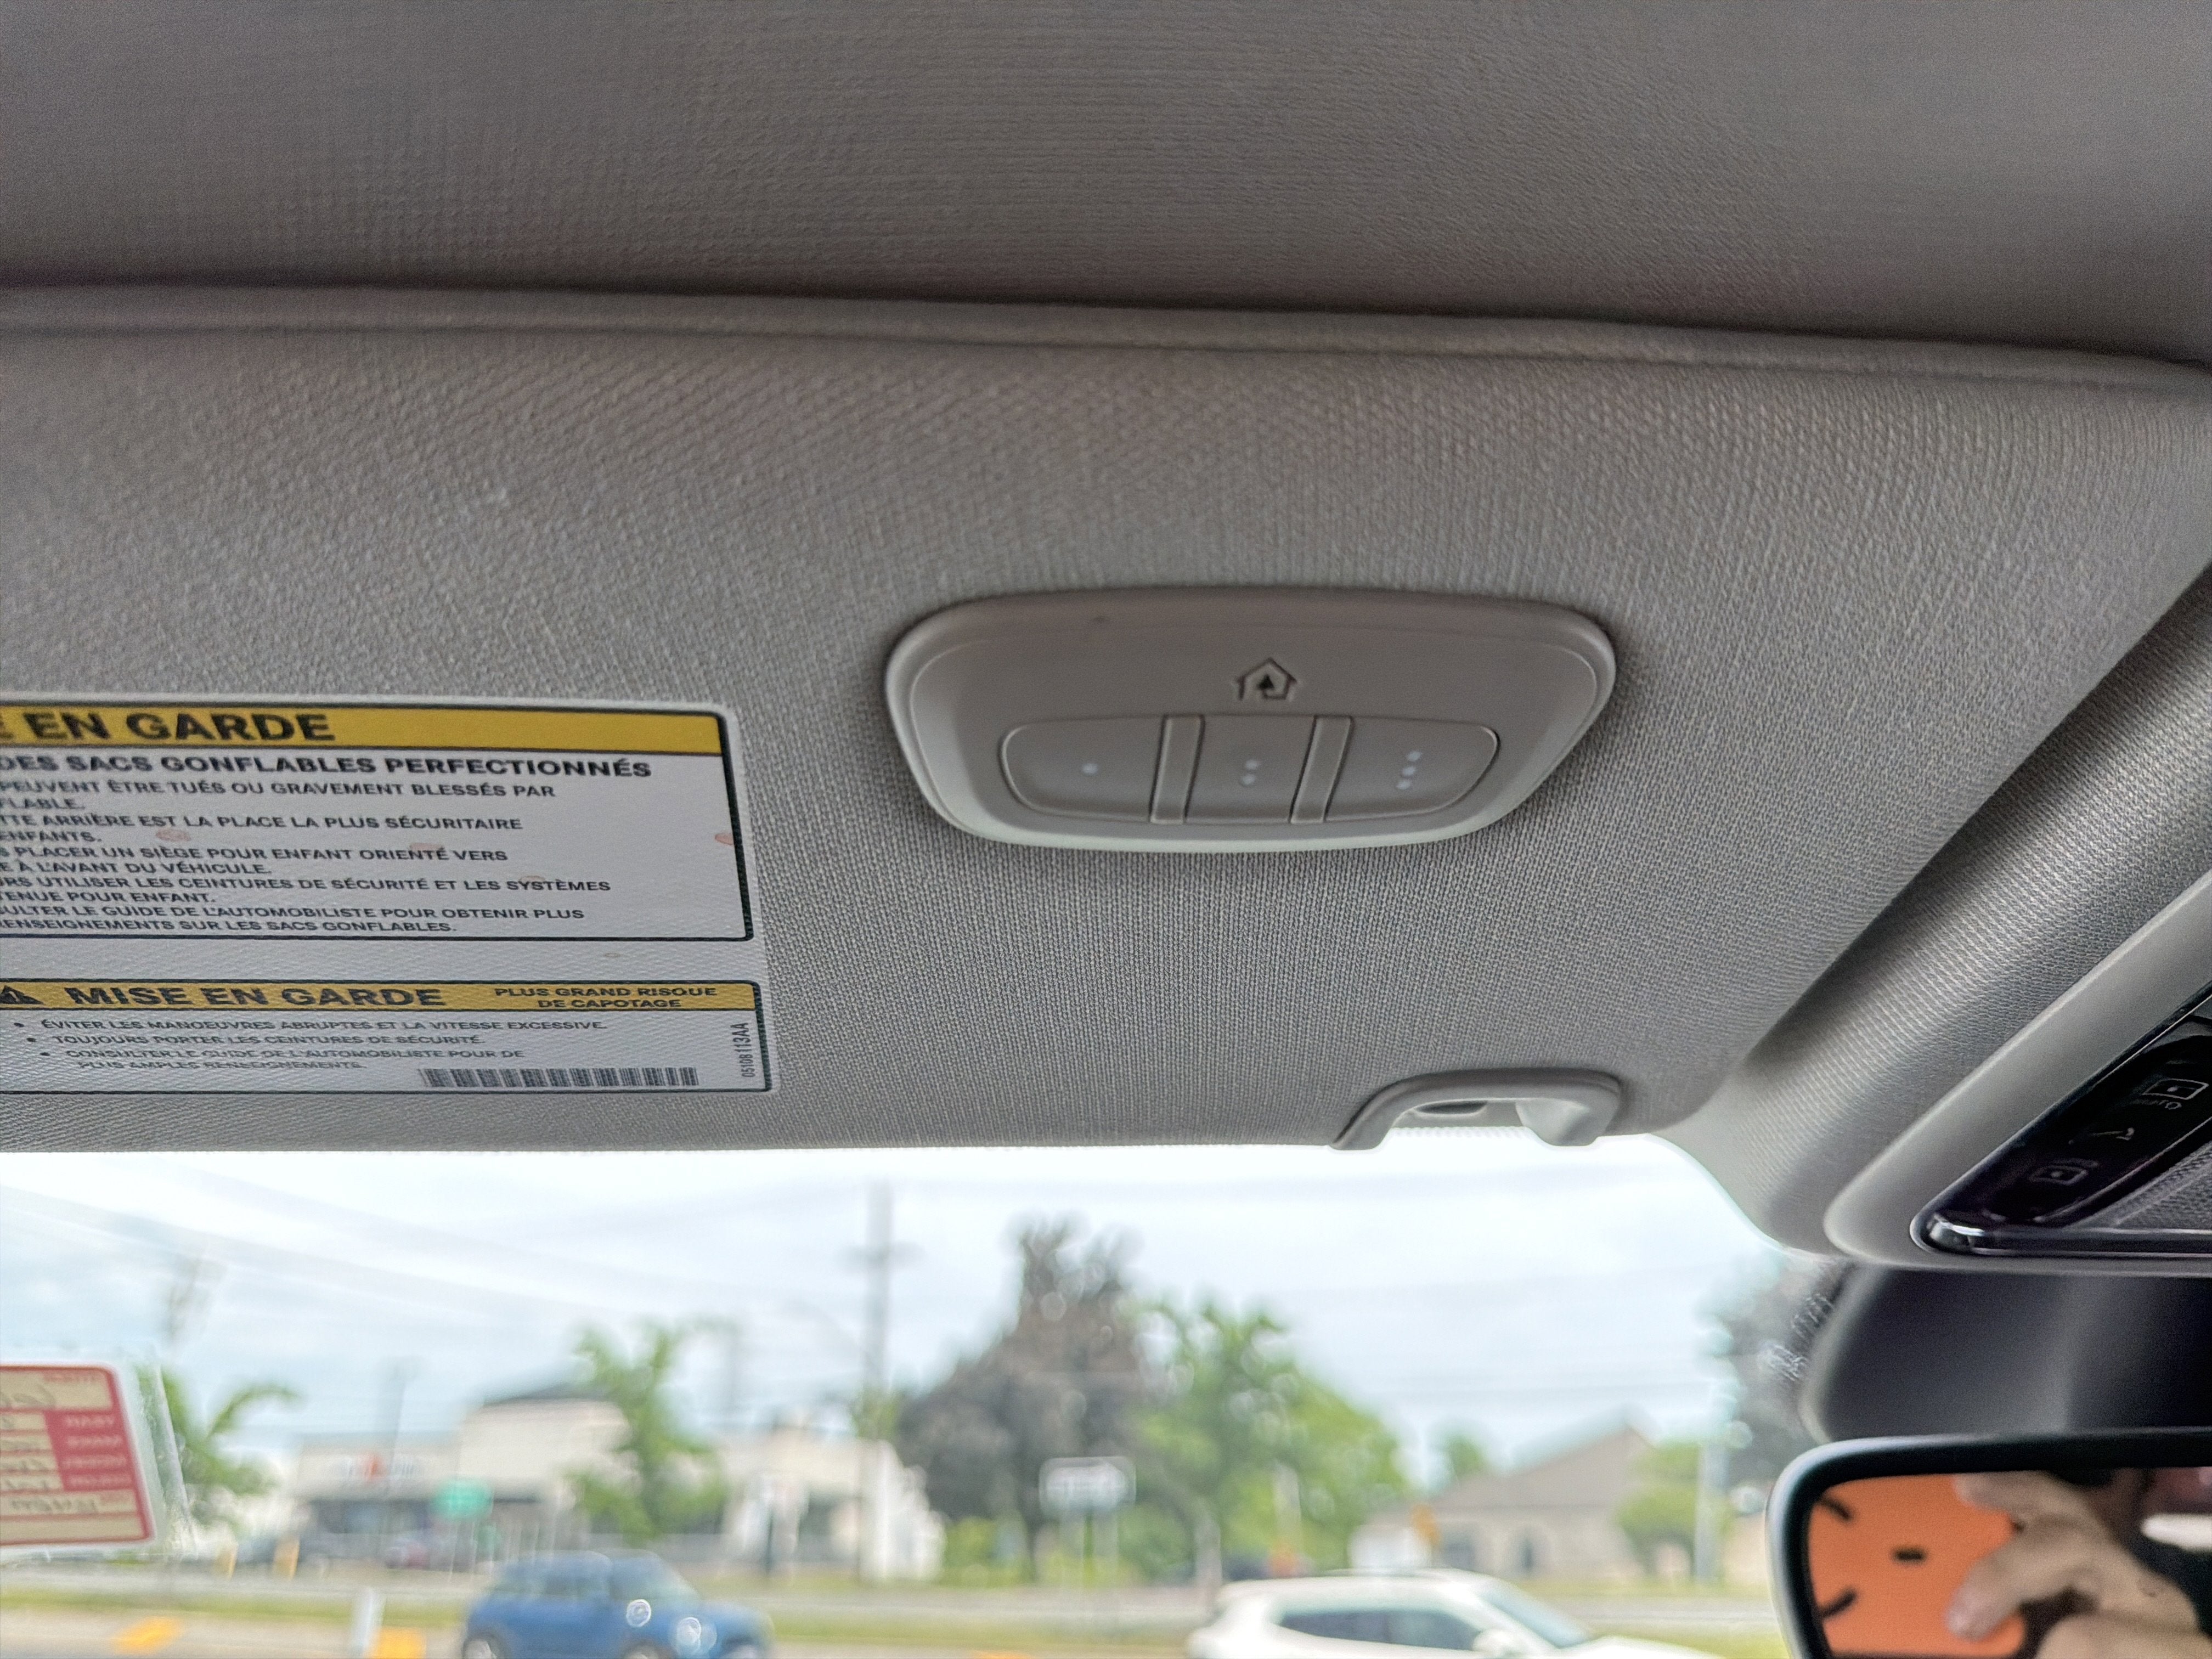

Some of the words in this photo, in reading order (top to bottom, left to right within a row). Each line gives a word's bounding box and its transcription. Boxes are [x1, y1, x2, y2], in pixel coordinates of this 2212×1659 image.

[24, 712, 110, 740] EN
[126, 713, 335, 741] GARDE
[66, 755, 152, 772] SACS
[161, 757, 376, 774] GONFLABLES
[385, 757, 652, 777] PERFECTIONNÉS
[108, 780, 165, 793] ÊTRE
[167, 780, 225, 794] TUÉS
[232, 783, 263, 794] OU
[271, 783, 403, 795] GRAVEMENT
[413, 782, 506, 797] BLESSÉS
[514, 786, 555, 797] PAR
[43, 813, 134, 827] ARRIÈRE
[138, 815, 176, 827] EST
[183, 816, 213, 827] LA
[218, 816, 286, 827] PLACE
[291, 816, 319, 828] LA
[325, 816, 379, 828] PLUS
[386, 815, 522, 830] SÉCURITAIRE
[14, 847, 99, 857] PLACER
[101, 847, 133, 858] UN
[140, 845, 202, 859] SIÈGE
[207, 848, 267, 860] POUR
[274, 848, 351, 860] ENFANT
[359, 847, 448, 861] ORIENTÉ
[454, 850, 507, 861] VERS
[125, 863, 158, 874] DU
[36, 876, 131, 888] UTILISER
[136, 878, 174, 888] LES
[179, 878, 292, 889] CEINTURES
[299, 878, 325, 889] DE
[331, 876, 429, 890] SÉCURITÉ
[435, 880, 459, 890] ET
[465, 881, 500, 890] LES
[506, 878, 611, 891] SYSTÈMES
[67, 891, 127, 902] POUR
[132, 892, 216, 902] ENFANT.
[71, 906, 99, 916] LE
[101, 906, 170, 917] GUIDE
[172, 906, 200, 917] DE
[382, 907, 438, 918] POUR
[443, 908, 529, 919] OBTENIR
[534, 909, 584, 919] PLUS
[179, 921, 219, 931] SUR
[225, 921, 262, 931] LES
[267, 922, 317, 932] SACS
[64, 987, 194, 1005] MISE
[199, 988, 269, 1005] EN
[281, 989, 445, 1006] GARDE
[555, 988, 631, 996] GRAND
[538, 999, 571, 1008] DE
[573, 999, 681, 1008] CAPOTAGE
[42, 1019, 106, 1029] ÉVITER
[109, 1021, 143, 1029] LES
[146, 1021, 274, 1029] MANOEUVRES
[281, 1021, 373, 1029] ABRUPTES
[447, 1050, 496, 1058] POUR
[500, 1050, 526, 1058] DE
